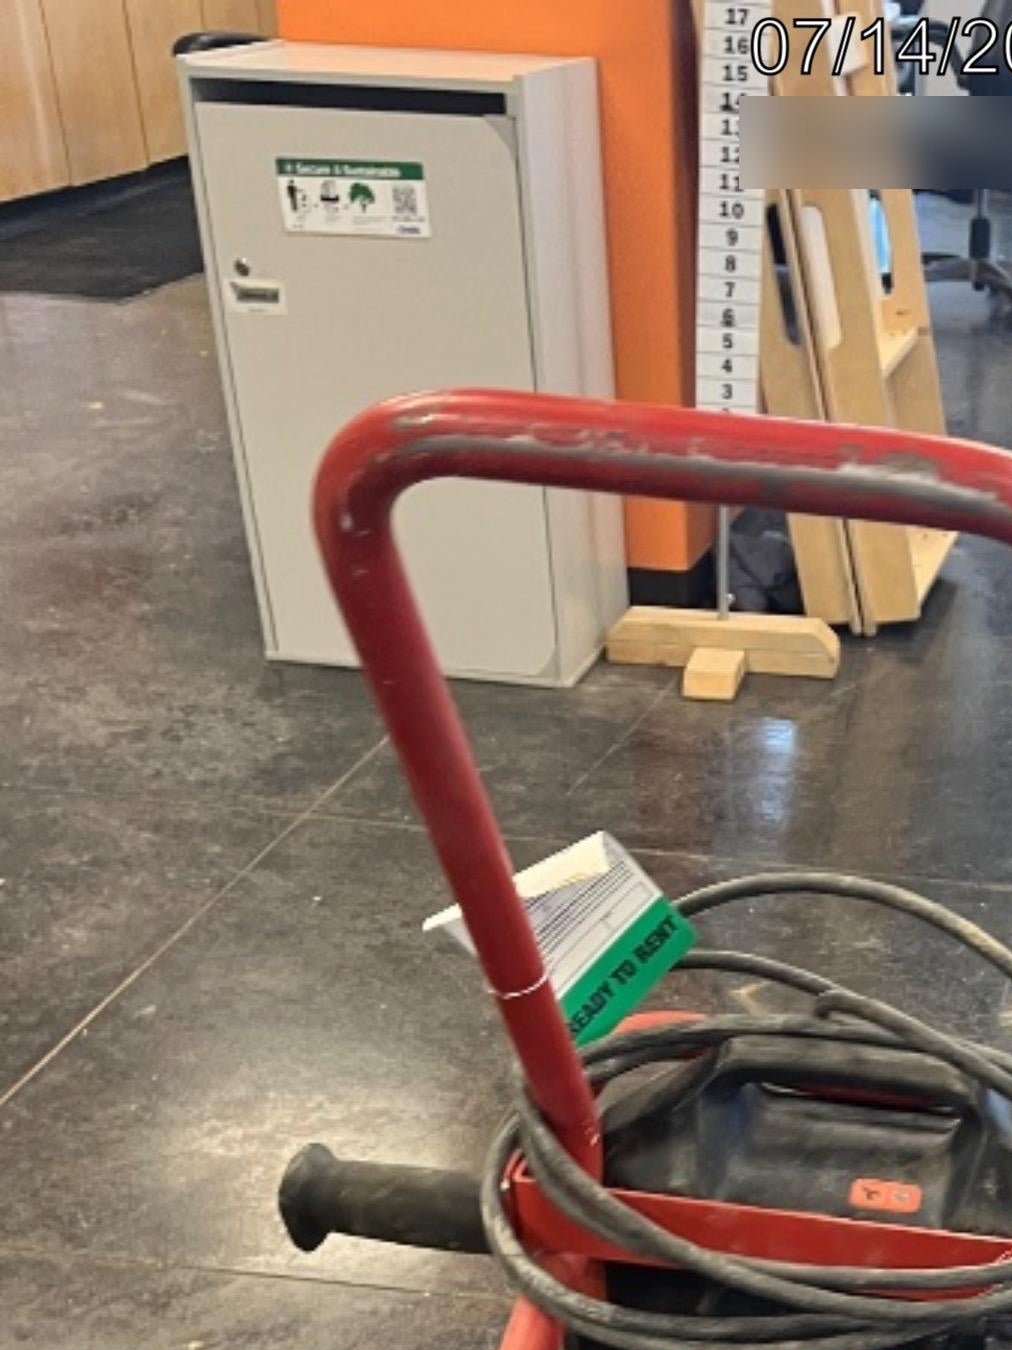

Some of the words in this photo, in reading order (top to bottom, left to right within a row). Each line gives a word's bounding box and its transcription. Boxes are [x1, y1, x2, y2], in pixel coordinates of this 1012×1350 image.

[725, 8, 749, 26] 17
[724, 36, 748, 54] 16
[722, 65, 748, 82] 15
[719, 201, 744, 219] 10
[726, 228, 739, 246] 9
[724, 255, 737, 273] 8
[724, 281, 735, 298] 7
[722, 308, 735, 327] 6
[723, 333, 734, 349] 5
[721, 358, 733, 374] 4
[721, 384, 733, 400] 3
[609, 959, 637, 985] TO
[633, 915, 679, 963] RENT
